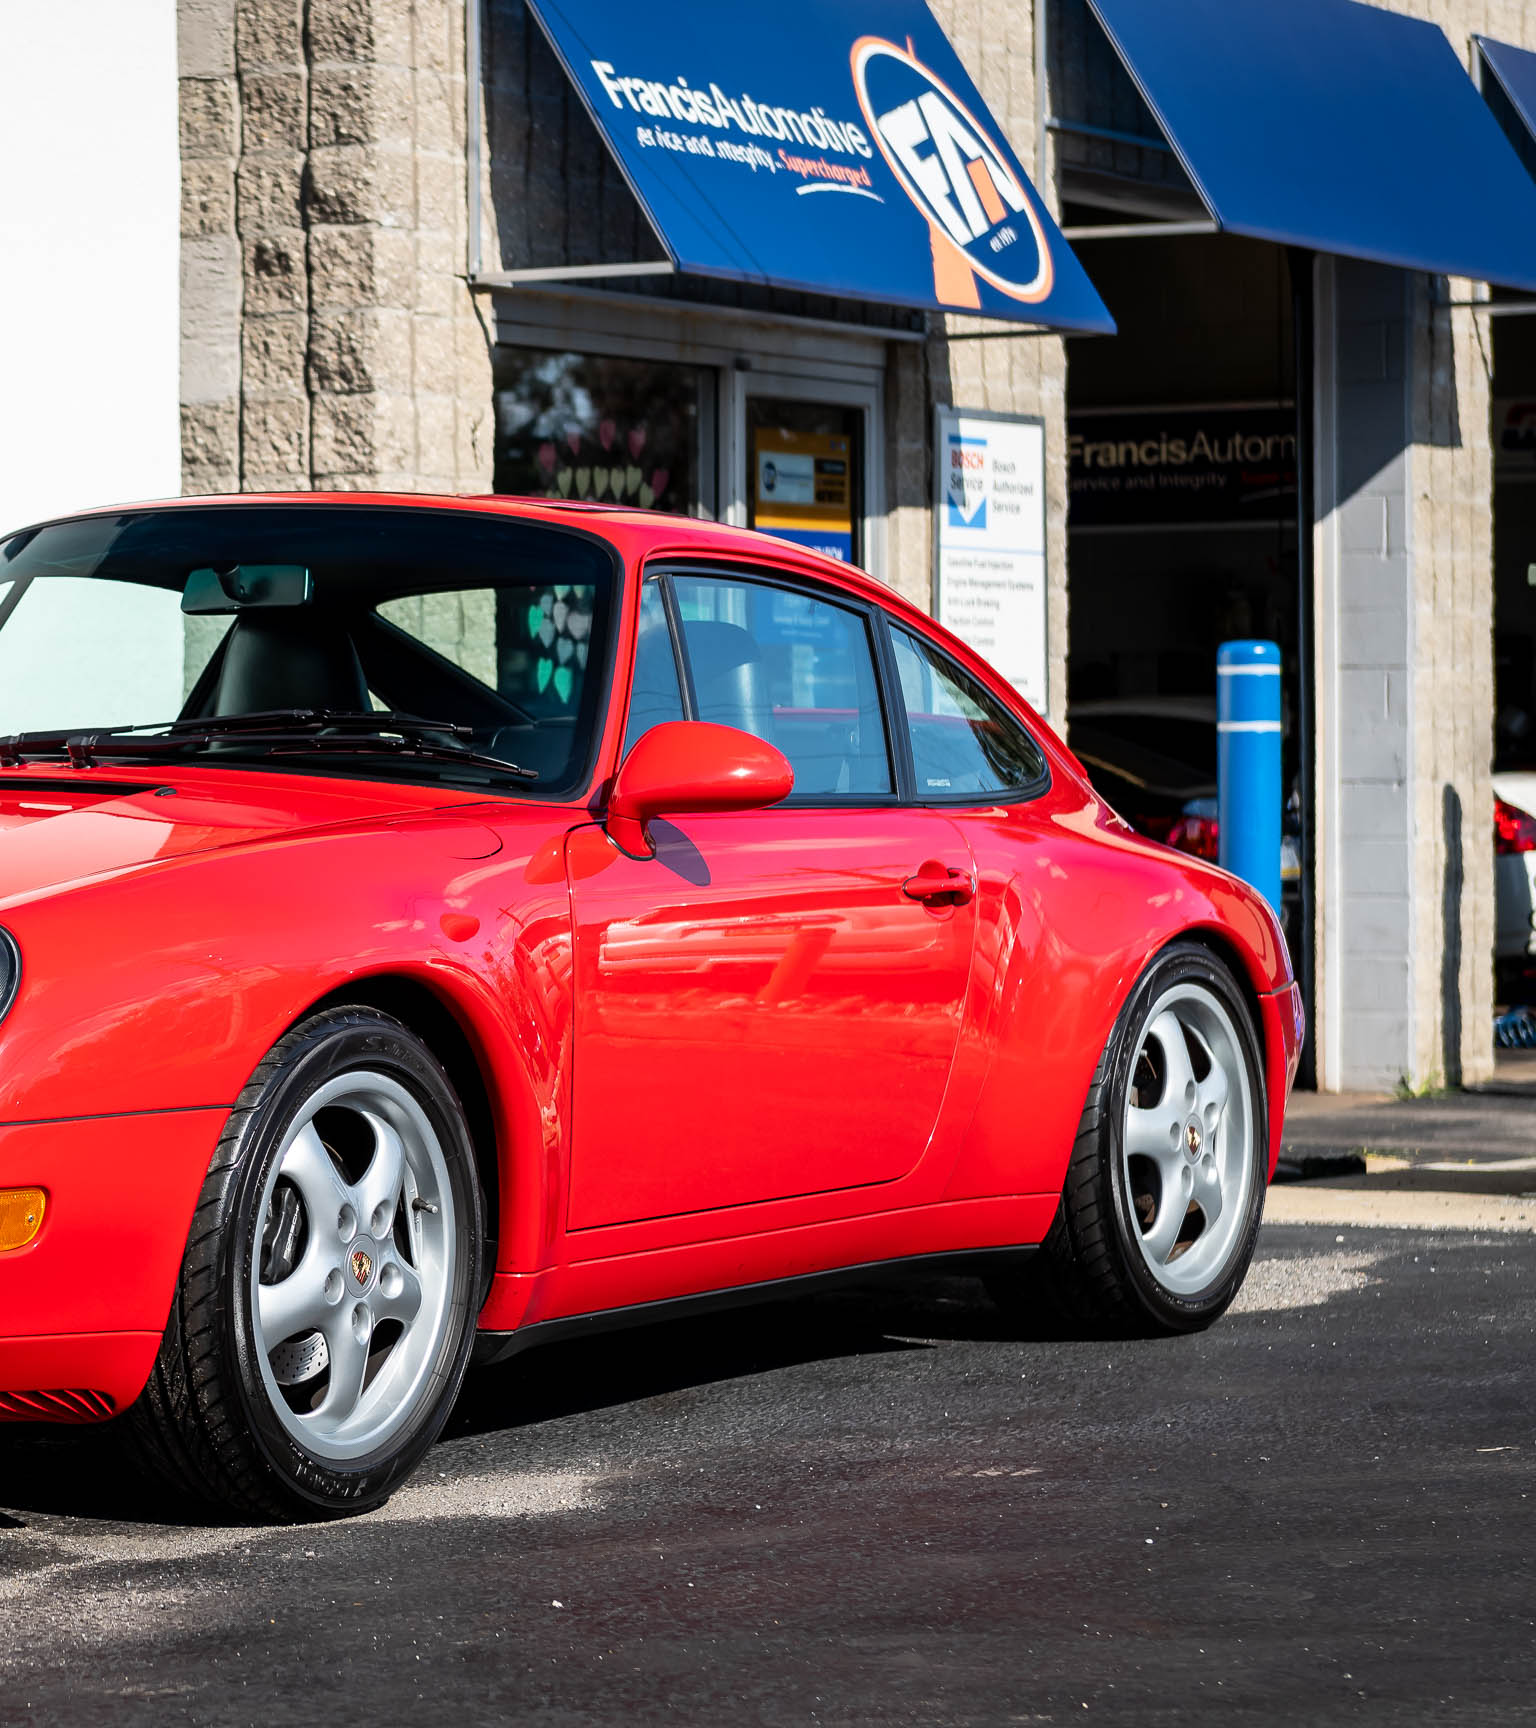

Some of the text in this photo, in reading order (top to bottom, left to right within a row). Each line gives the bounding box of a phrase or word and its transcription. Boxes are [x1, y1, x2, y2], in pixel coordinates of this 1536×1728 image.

[591, 59, 873, 159] FrancisAutomotive
[777, 148, 873, 189] Supercharged
[951, 448, 984, 471] BOSCH
[992, 458, 1016, 473] Bosch
[950, 472, 983, 492] Service
[992, 479, 1034, 497] Authorized
[1124, 470, 1156, 491] and
[992, 501, 1021, 515] Service
